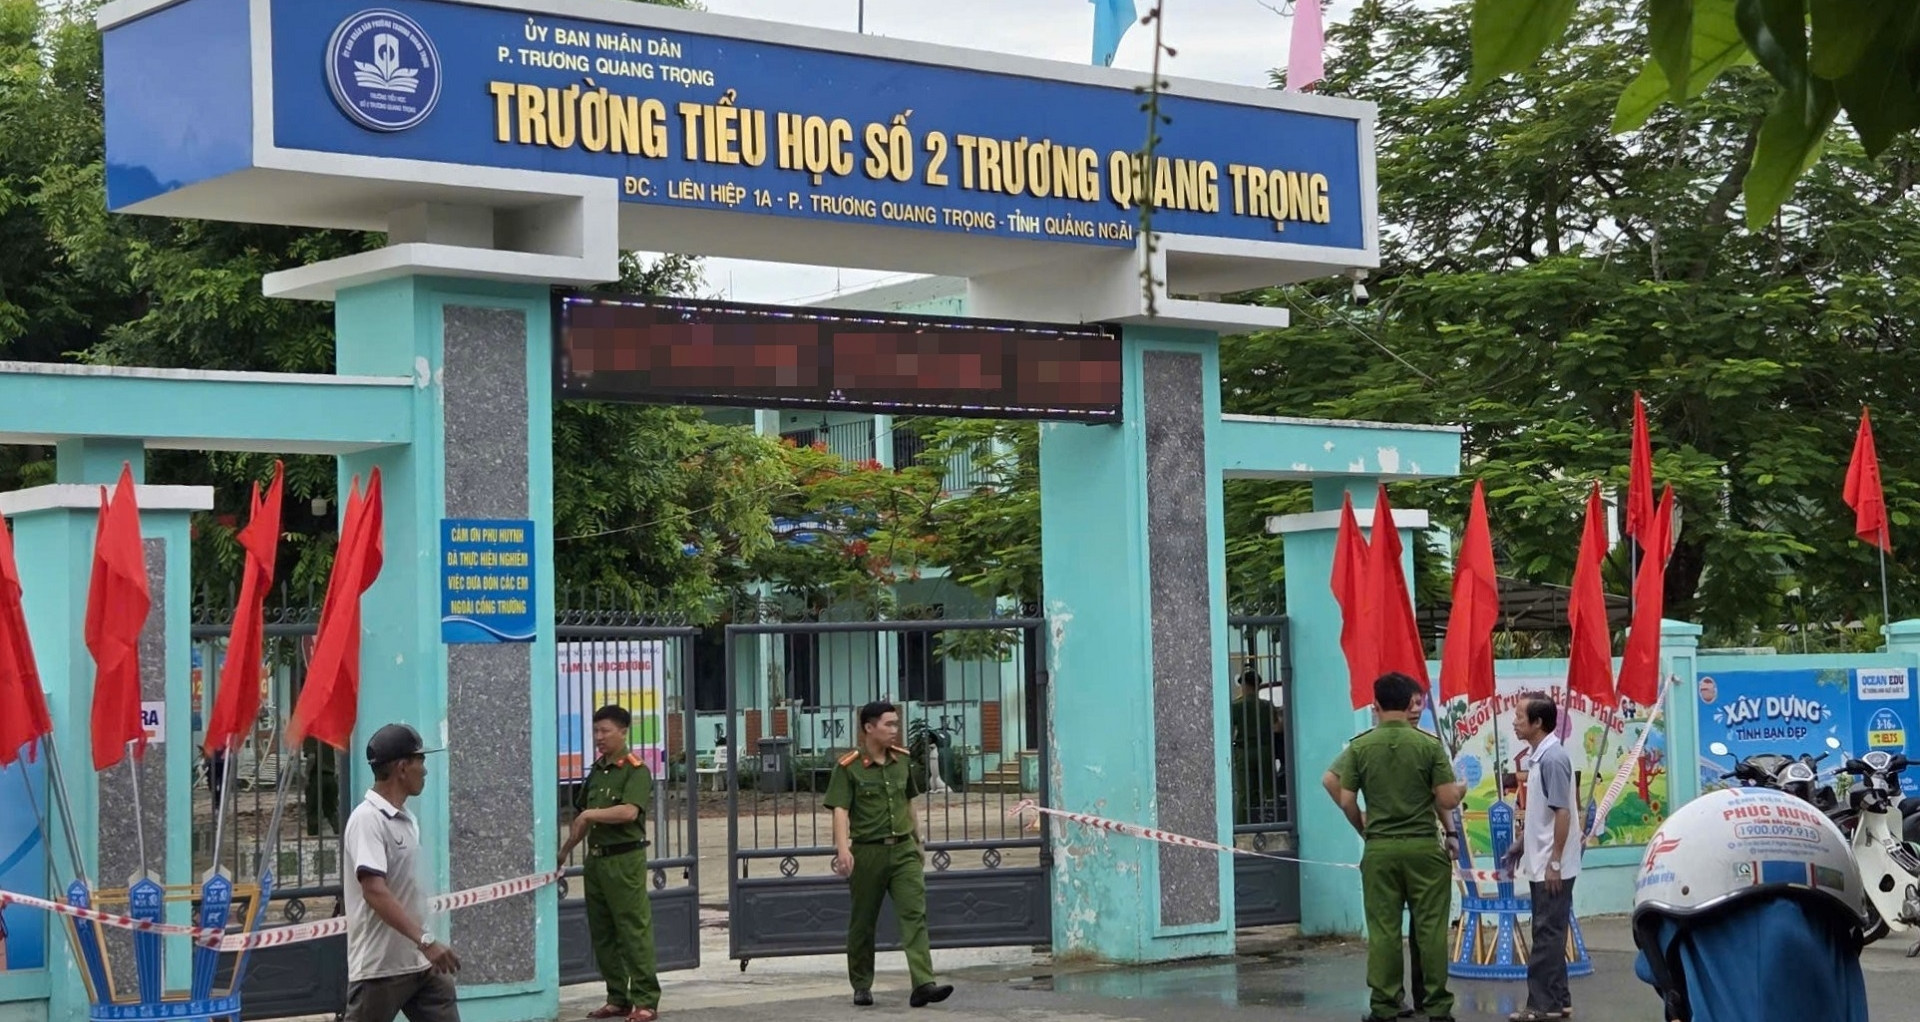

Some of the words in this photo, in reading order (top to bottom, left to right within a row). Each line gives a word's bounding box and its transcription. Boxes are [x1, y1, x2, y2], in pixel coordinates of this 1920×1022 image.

[524, 17, 548, 41] ỦY
[555, 28, 590, 48] BAN
[596, 33, 642, 54] NHÂN
[648, 37, 682, 59] DÂN
[498, 46, 513, 64] P.
[518, 48, 590, 73] TRƯƠNG
[596, 58, 654, 80] QUANG
[659, 65, 715, 88] TRỌNG
[490, 77, 668, 158] TRƯỜNG
[679, 88, 767, 167] TIỂU
[777, 111, 854, 186] HỌC
[864, 109, 914, 182] SỐ
[925, 131, 949, 186] 2
[956, 134, 1100, 202] TRƯƠNG
[1228, 163, 1331, 232] TRỌNG
[667, 179, 705, 201] LIÊN
[711, 185, 746, 208] HIỆP
[753, 190, 772, 208] 1A
[789, 192, 803, 210] P.
[810, 194, 877, 218] TRƯƠNG
[881, 202, 937, 224] QUANG
[942, 207, 995, 231] TRỌNG
[1007, 208, 1040, 234] TỈNH
[1045, 213, 1095, 238] QUẢNG
[1098, 219, 1133, 241] NGÃI
[451, 523, 469, 543] CẢM
[470, 527, 481, 543] ƠN
[482, 528, 498, 546] PHỤ
[499, 528, 524, 543] HUYNH
[447, 548, 458, 567] ĐÃ
[459, 551, 479, 569] THỰC
[480, 548, 498, 570] HIỆN
[499, 548, 528, 567] NGHIÊM
[448, 573, 465, 593] VIỆC
[466, 574, 482, 590] ĐƯA
[483, 573, 499, 590] ĐÓN
[500, 573, 515, 591] CÁC
[516, 576, 529, 590] EM
[450, 596, 474, 614] NGOÀI
[475, 594, 496, 614] CỔNG
[497, 596, 527, 614] TRƯỜNG
[1861, 675, 1887, 686] OCEAN
[1888, 675, 1904, 685] EDU
[1723, 695, 1761, 725] XÂY
[1766, 694, 1821, 723] DỰNG
[1736, 727, 1761, 740] TÌNH
[1764, 727, 1785, 741] BẠN
[1787, 726, 1807, 740] ĐẸP
[1723, 803, 1771, 821] PHÚC
